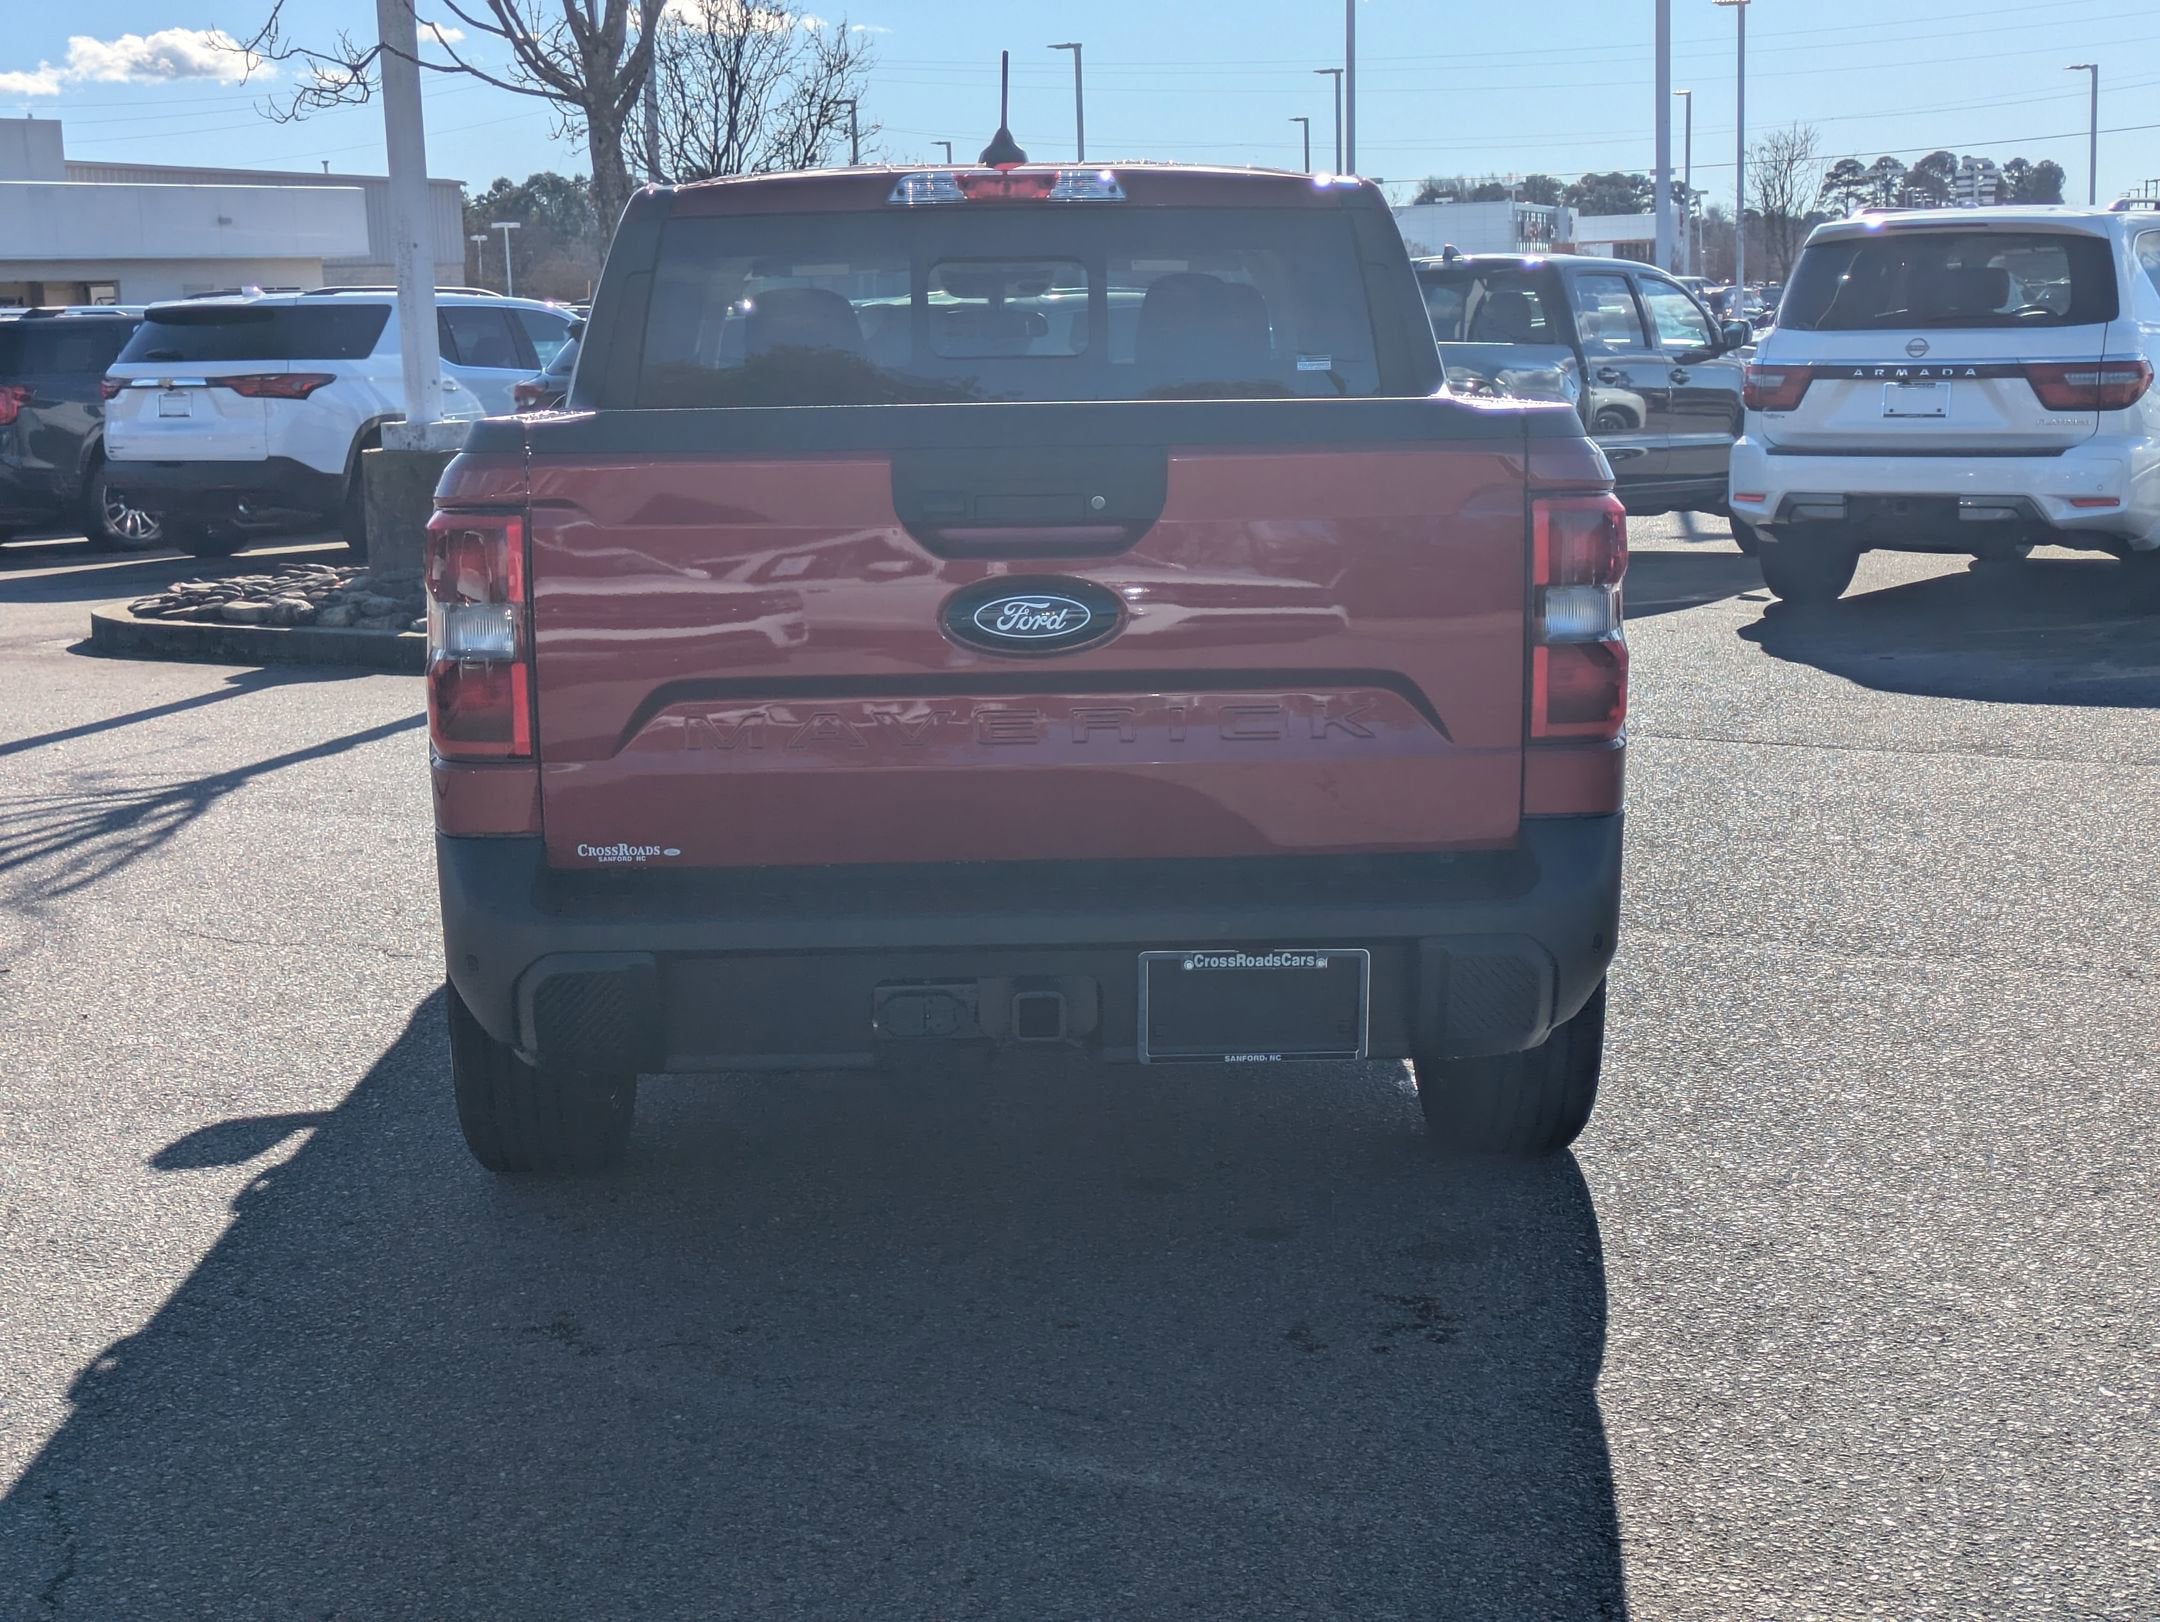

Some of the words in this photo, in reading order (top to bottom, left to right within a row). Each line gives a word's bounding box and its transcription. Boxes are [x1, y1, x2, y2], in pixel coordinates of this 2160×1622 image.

[1853, 368, 1977, 377] ARMADA
[996, 601, 1069, 631] Ford
[684, 702, 1377, 751] MAVERICK
[1193, 952, 1315, 968] CrossRoadsCars
[1269, 1054, 1282, 1062] NC
